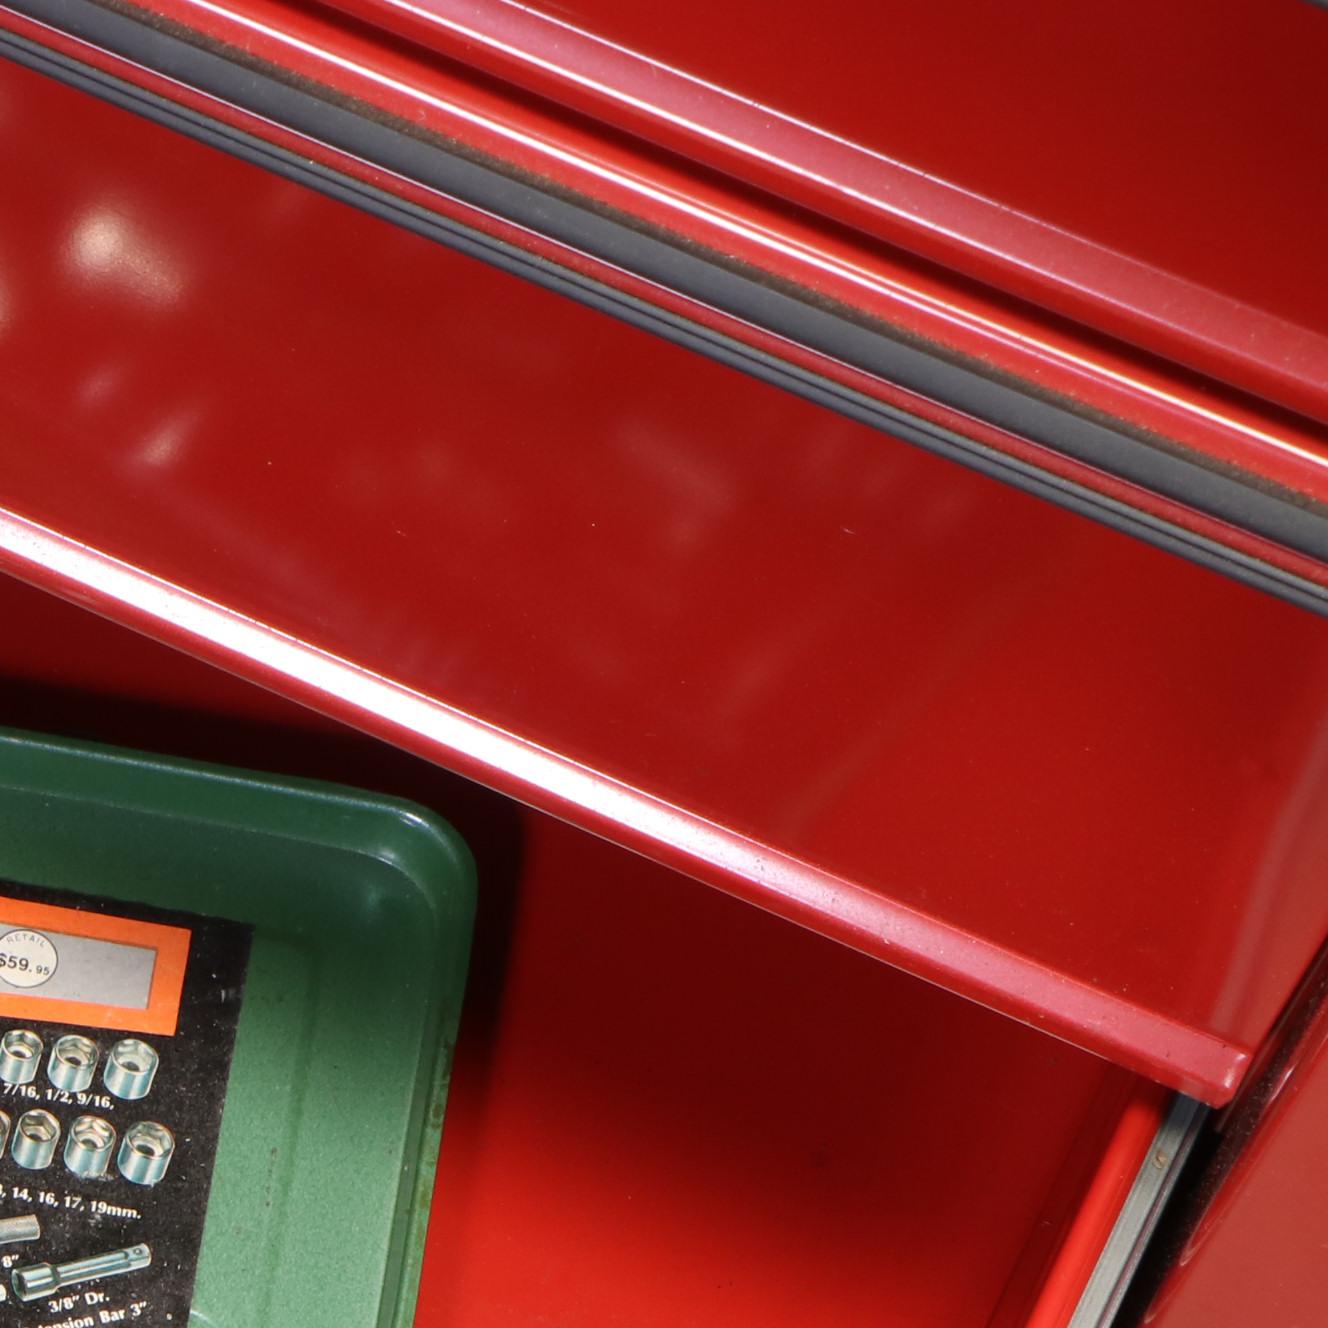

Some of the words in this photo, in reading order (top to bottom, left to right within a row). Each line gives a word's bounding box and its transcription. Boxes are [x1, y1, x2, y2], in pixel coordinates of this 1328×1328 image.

[3, 1082, 40, 1100] 7/16,
[45, 1087, 73, 1105] 1/2,
[77, 1092, 114, 1110] 9/16,
[12, 1186, 33, 1203] 14,
[38, 1191, 59, 1207] 16,
[64, 1195, 85, 1212] 17,
[90, 1200, 142, 1220] 19mm.
[84, 1290, 111, 1305] Dr.
[99, 1307, 126, 1324] Bar
